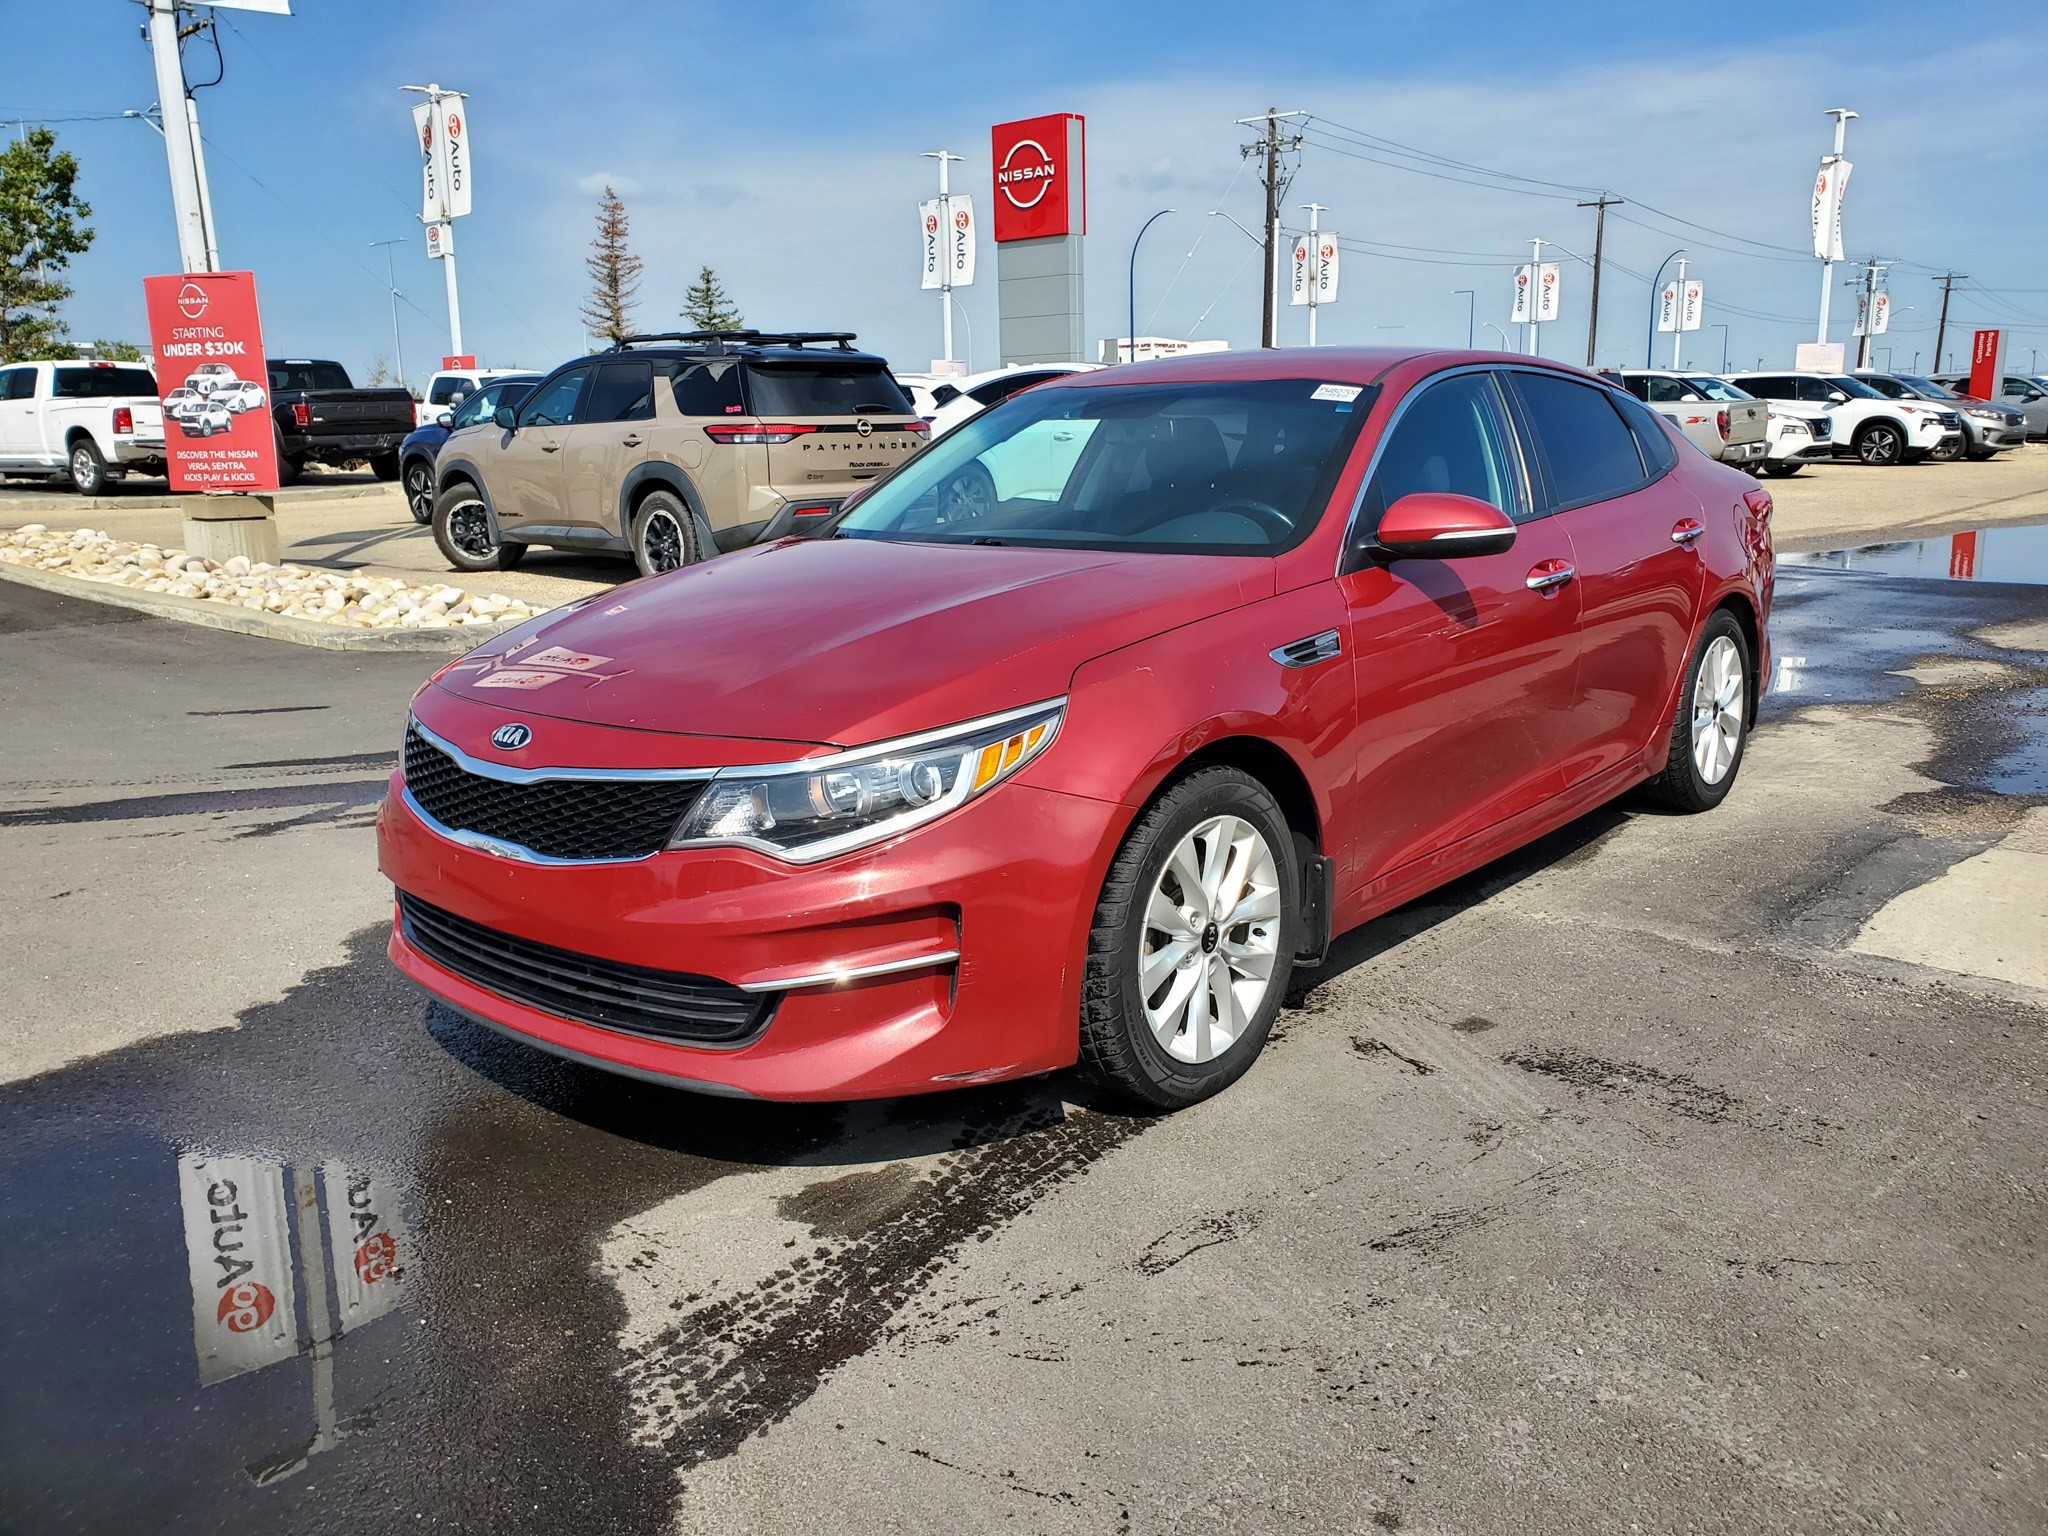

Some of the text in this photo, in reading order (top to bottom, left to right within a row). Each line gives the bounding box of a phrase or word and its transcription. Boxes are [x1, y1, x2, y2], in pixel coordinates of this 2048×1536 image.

[448, 113, 462, 191] go Auto
[425, 150, 434, 200] Auto
[998, 164, 1055, 183] NISSAN
[926, 214, 938, 273] go Auto
[955, 210, 969, 270] go Auto
[1295, 261, 1303, 292] Auto
[1320, 259, 1330, 290] Auto
[177, 297, 209, 305] NISSAN
[1517, 287, 1525, 312] Auto
[1542, 285, 1551, 310] Auto
[1663, 300, 1671, 323] Auto
[1686, 299, 1695, 322] Auto
[1875, 307, 1883, 326] Auto
[172, 326, 225, 340] STARTING
[1985, 331, 1995, 357] Parking
[162, 341, 246, 357] UNDER $30K
[1976, 332, 1985, 364] Customer
[176, 450, 258, 459] DISCOVER THE NISSAN
[802, 441, 918, 451] PATHFINDER
[184, 472, 256, 481] KICKS PLAY & KICKS
[187, 461, 247, 471] VERSA, SENTRA,
[493, 725, 525, 746] KIA
[1206, 926, 1216, 952] KIA
